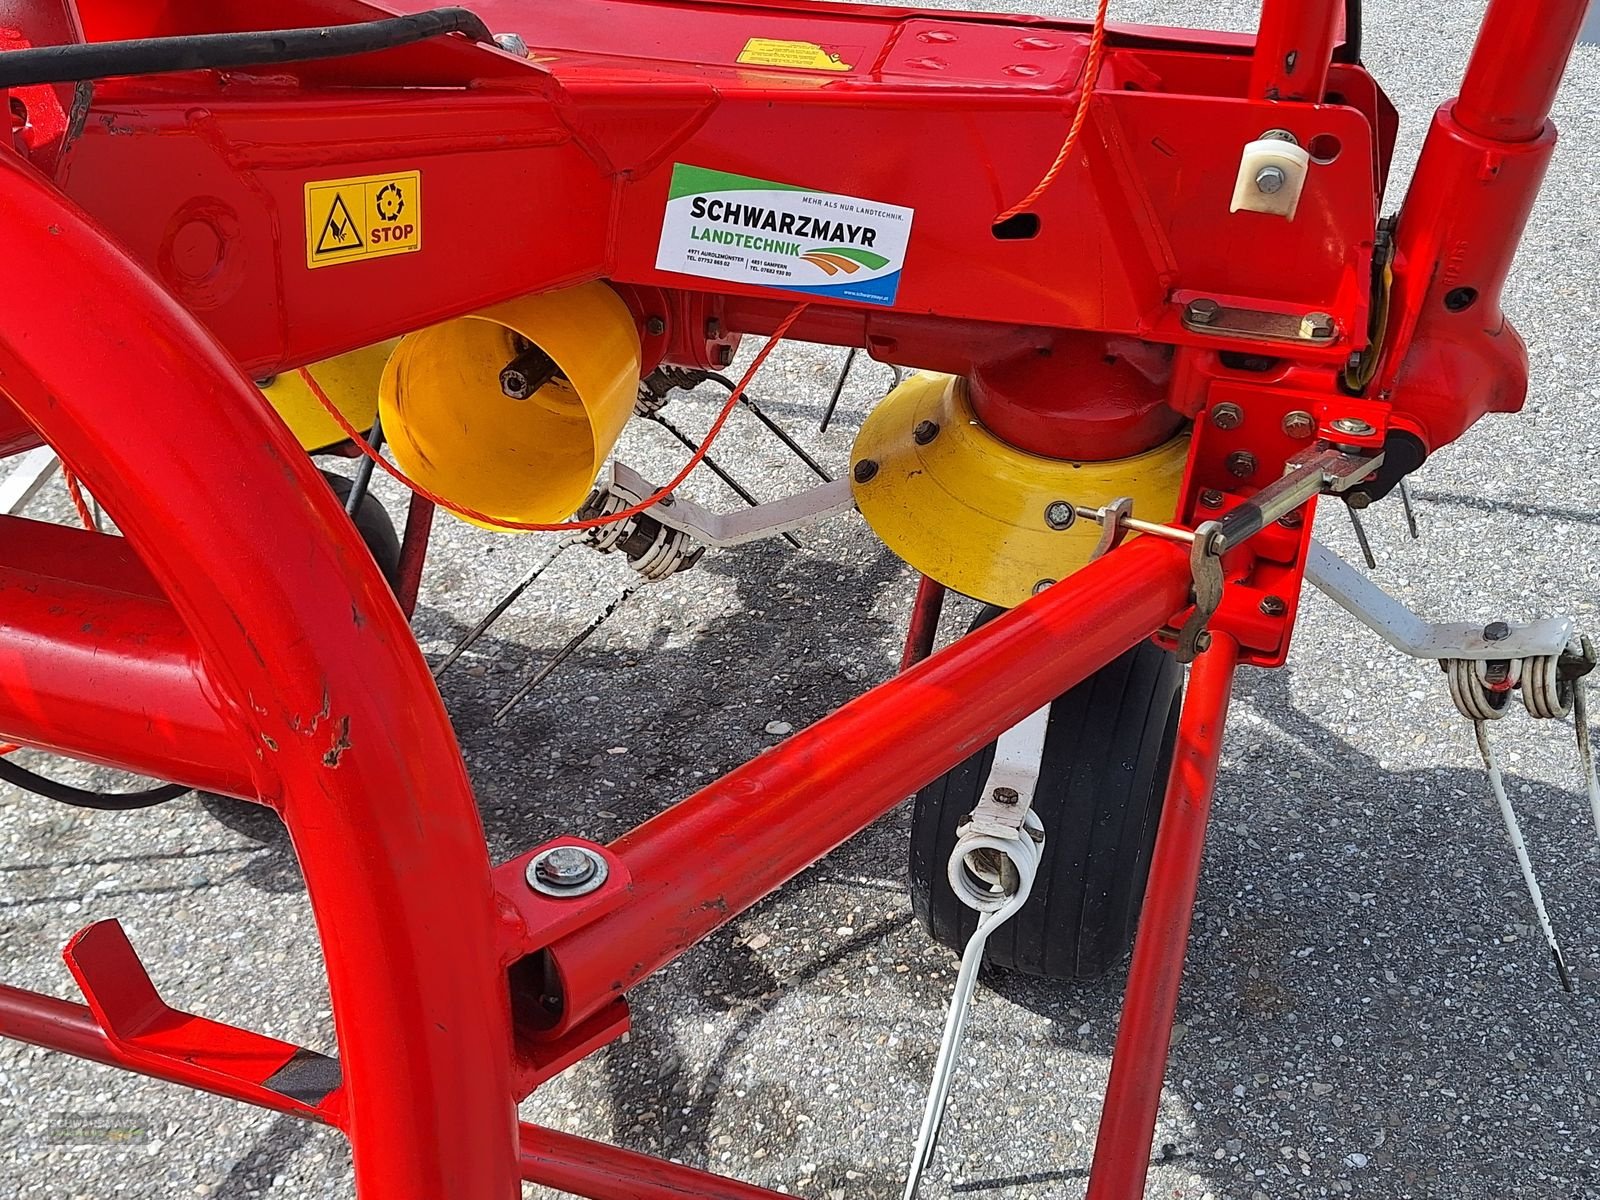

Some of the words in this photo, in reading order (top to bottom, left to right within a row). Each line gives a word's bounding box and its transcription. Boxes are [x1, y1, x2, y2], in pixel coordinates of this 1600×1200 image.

[802, 196, 823, 206] MEHR
[825, 201, 838, 209] ALS
[840, 203, 854, 212] NUR
[856, 207, 904, 221] LANDTECHNIK.
[690, 196, 877, 248] SCHWARZMAYR
[371, 224, 414, 244] STOP
[690, 225, 801, 257] LANDTECHNIK
[686, 254, 697, 262] TEL.
[687, 248, 700, 256] 4971
[701, 250, 745, 262] AUROLZMÜNSTER
[763, 261, 788, 270] GAMPERN
